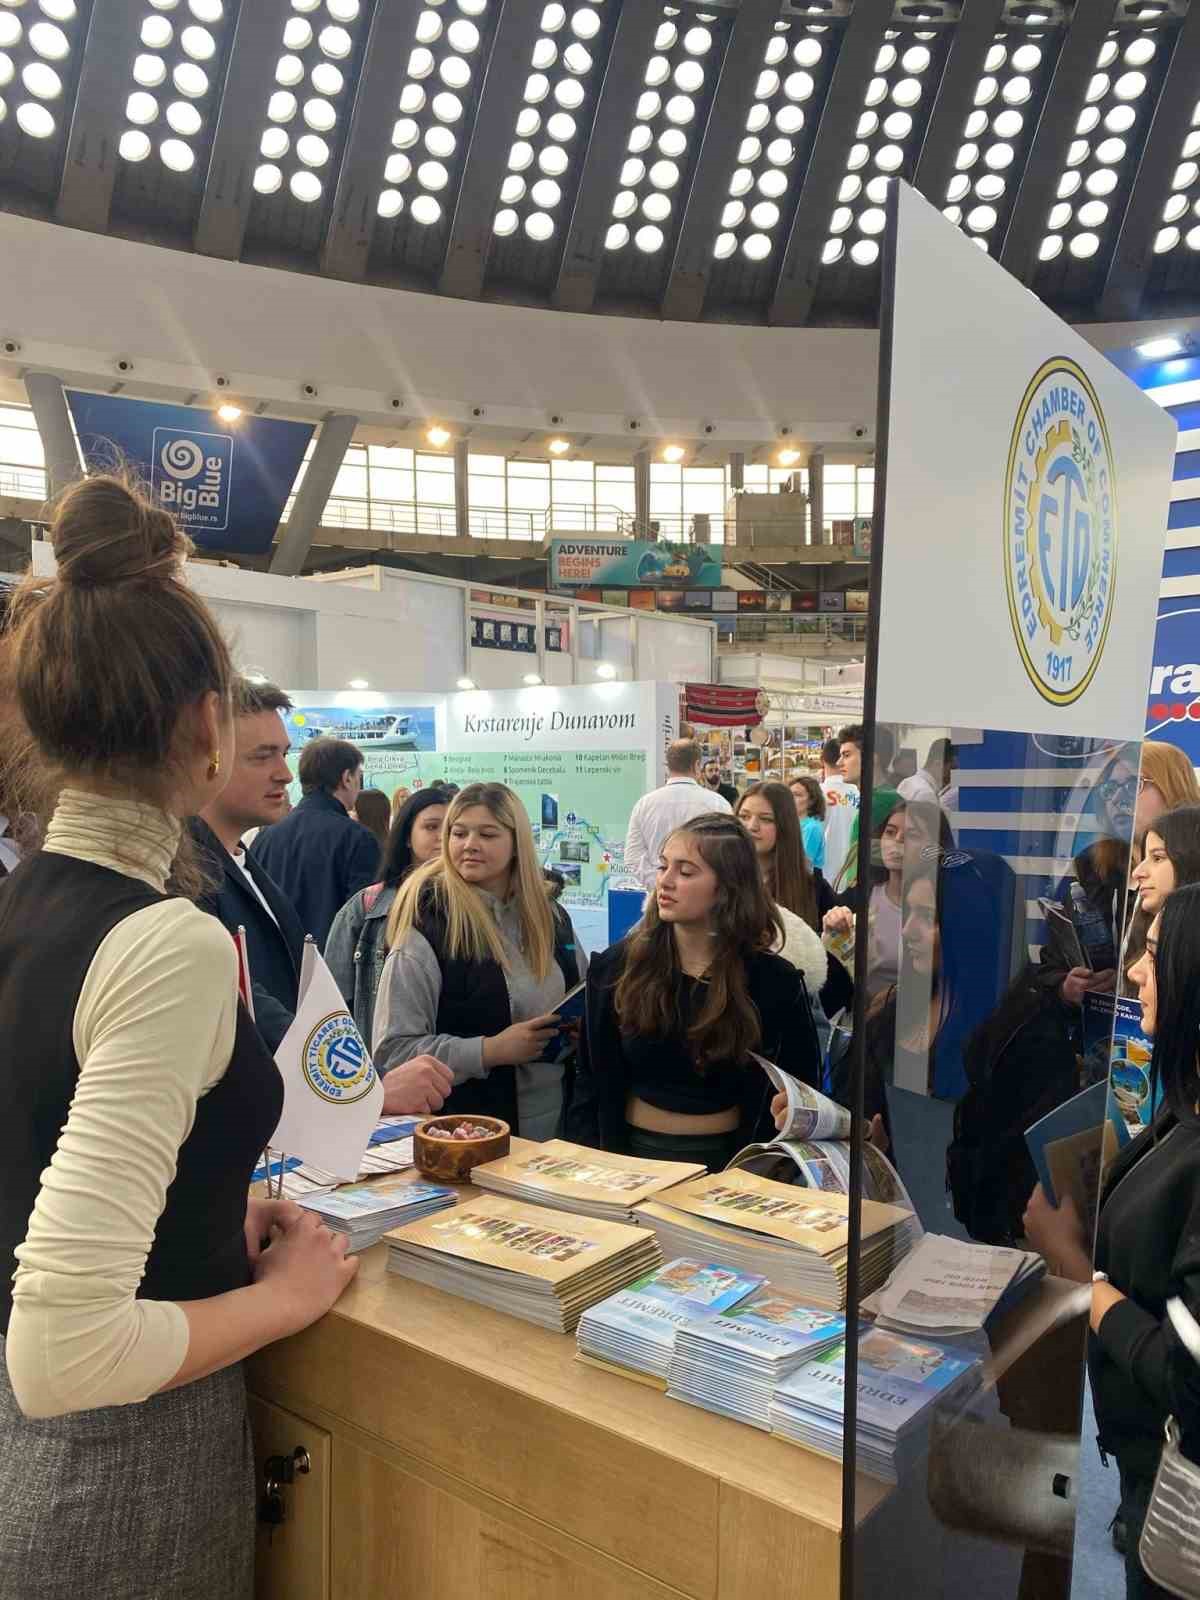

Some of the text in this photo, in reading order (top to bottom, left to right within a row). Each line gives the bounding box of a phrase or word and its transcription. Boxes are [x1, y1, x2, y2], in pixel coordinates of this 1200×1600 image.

[1025, 387, 1086, 456] CHAMBER
[1088, 420, 1103, 457] OF
[160, 456, 222, 510] Big Blue
[558, 544, 628, 556] ADVENTURE
[558, 557, 601, 567] BEGINS
[558, 568, 591, 578] HERE!
[1046, 651, 1072, 683] 1917
[465, 711, 636, 740] Krstarenje Dunavom
